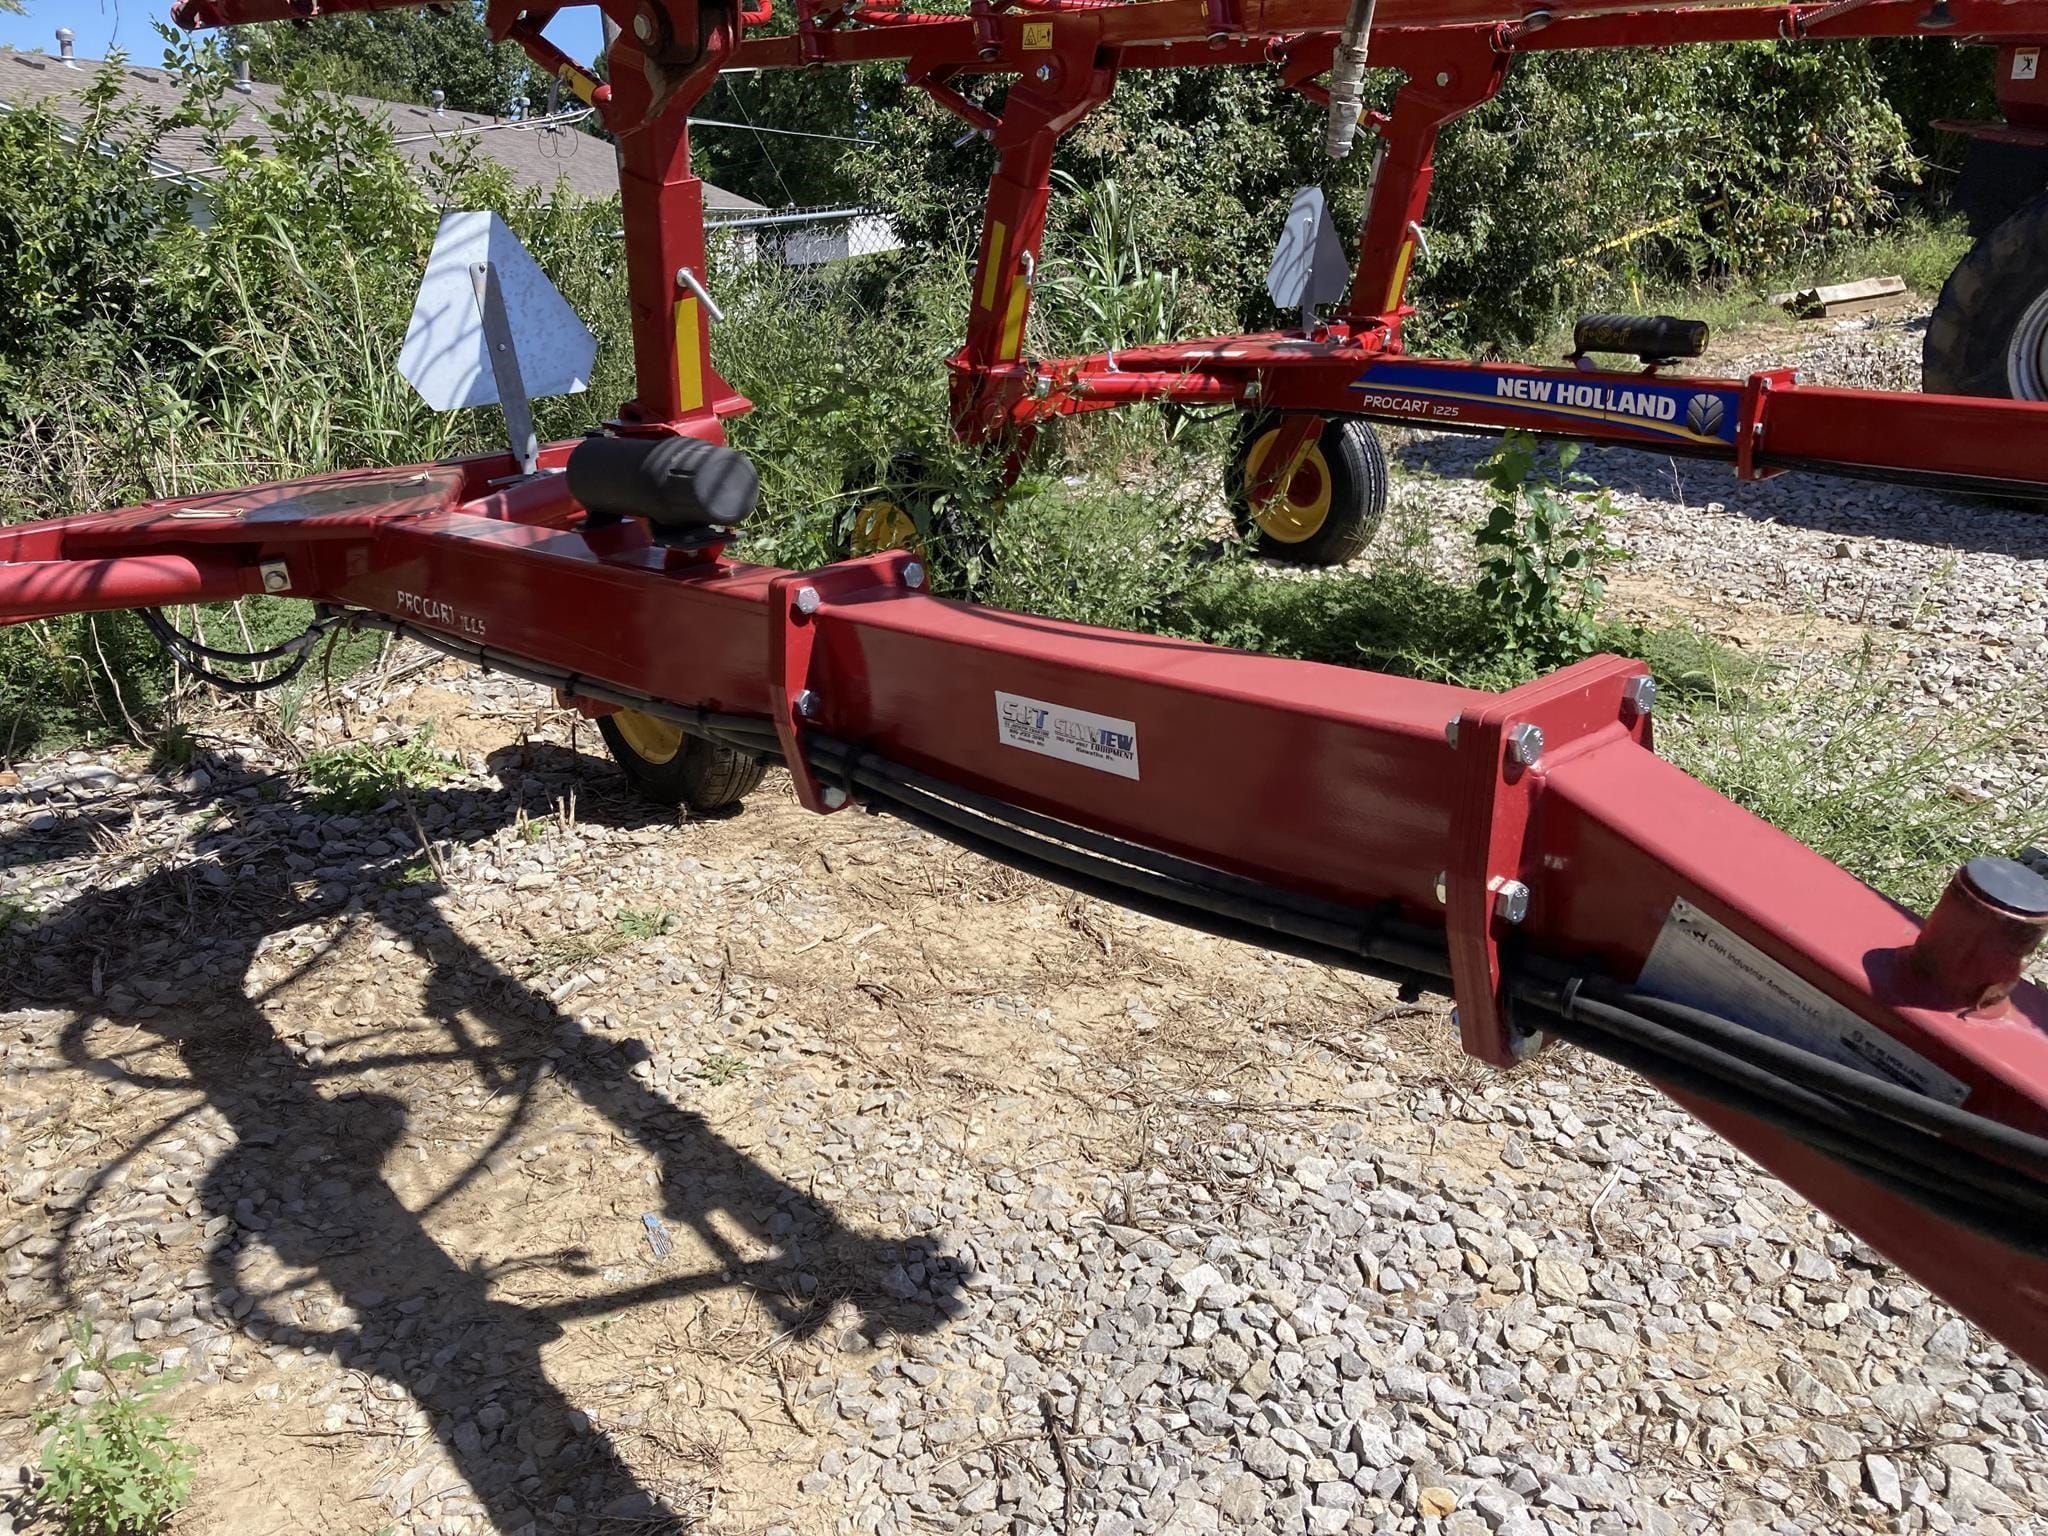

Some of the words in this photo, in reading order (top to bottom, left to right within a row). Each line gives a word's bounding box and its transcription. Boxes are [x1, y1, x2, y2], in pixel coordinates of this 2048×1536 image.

[1363, 394, 1429, 413] PROCART
[1432, 406, 1459, 416] 1225
[1496, 377, 1552, 402] NEW
[1556, 383, 1676, 421] HOLLAND
[1090, 742, 1134, 760] EQUIPMENT
[1707, 938, 1727, 956] CNH
[1727, 951, 1766, 982] Industrial
